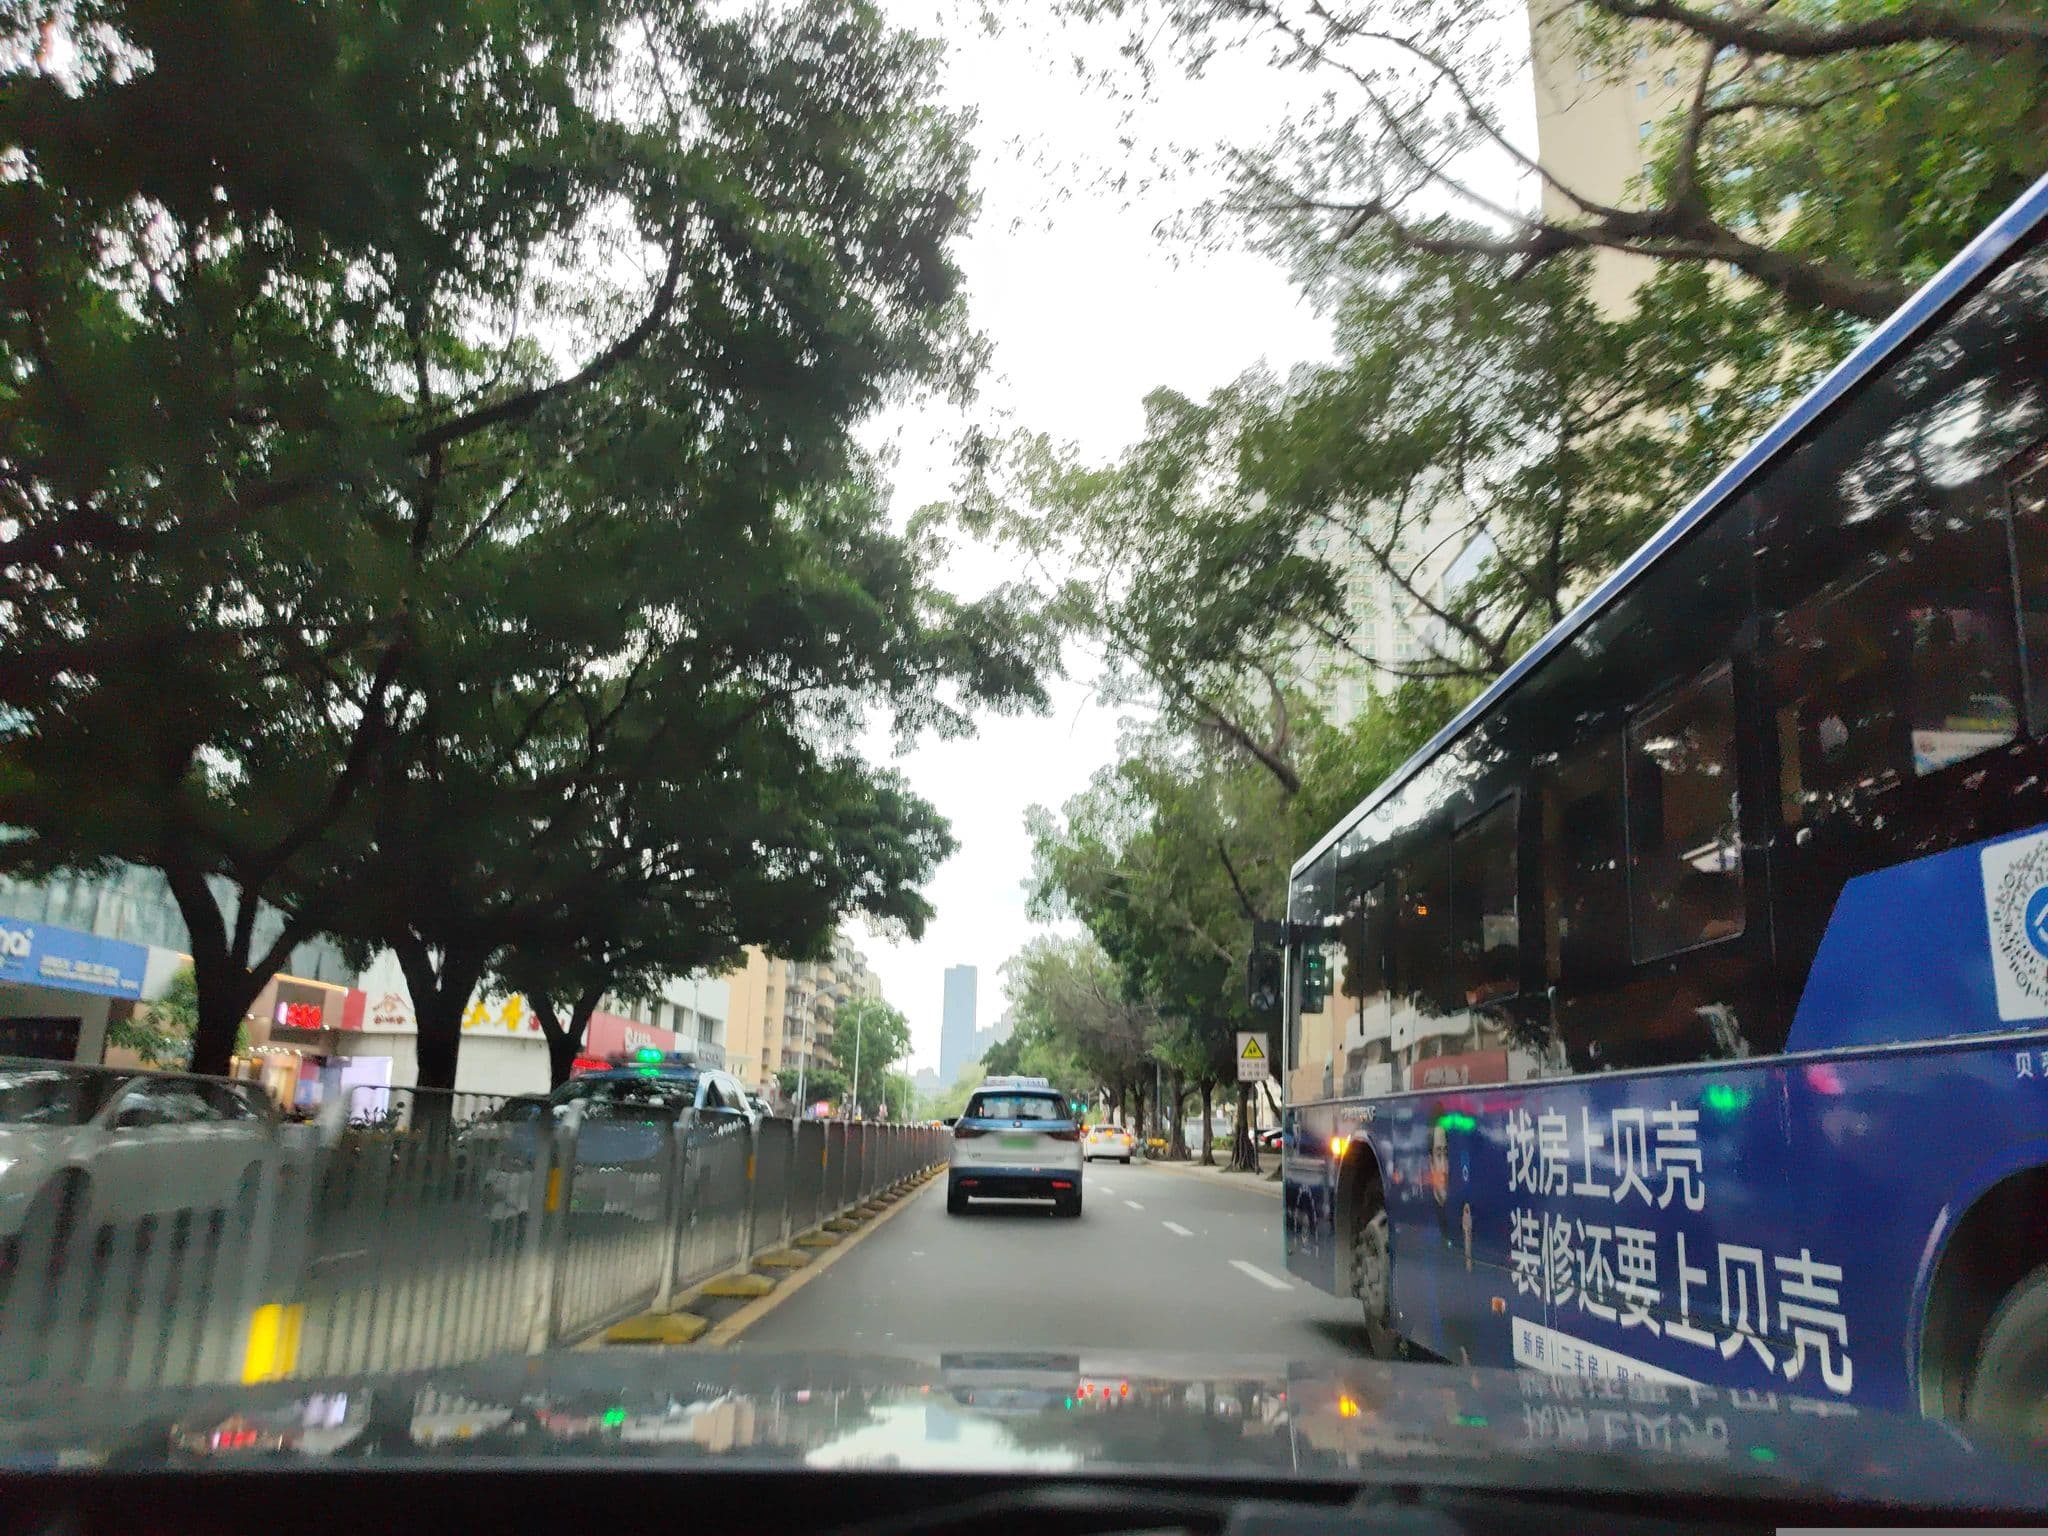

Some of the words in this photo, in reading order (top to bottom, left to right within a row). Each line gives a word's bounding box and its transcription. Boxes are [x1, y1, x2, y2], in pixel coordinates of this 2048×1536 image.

[1506, 1101, 1704, 1211] 找房上贝壳
[1510, 1207, 1852, 1394] 装修还要上贝壳
